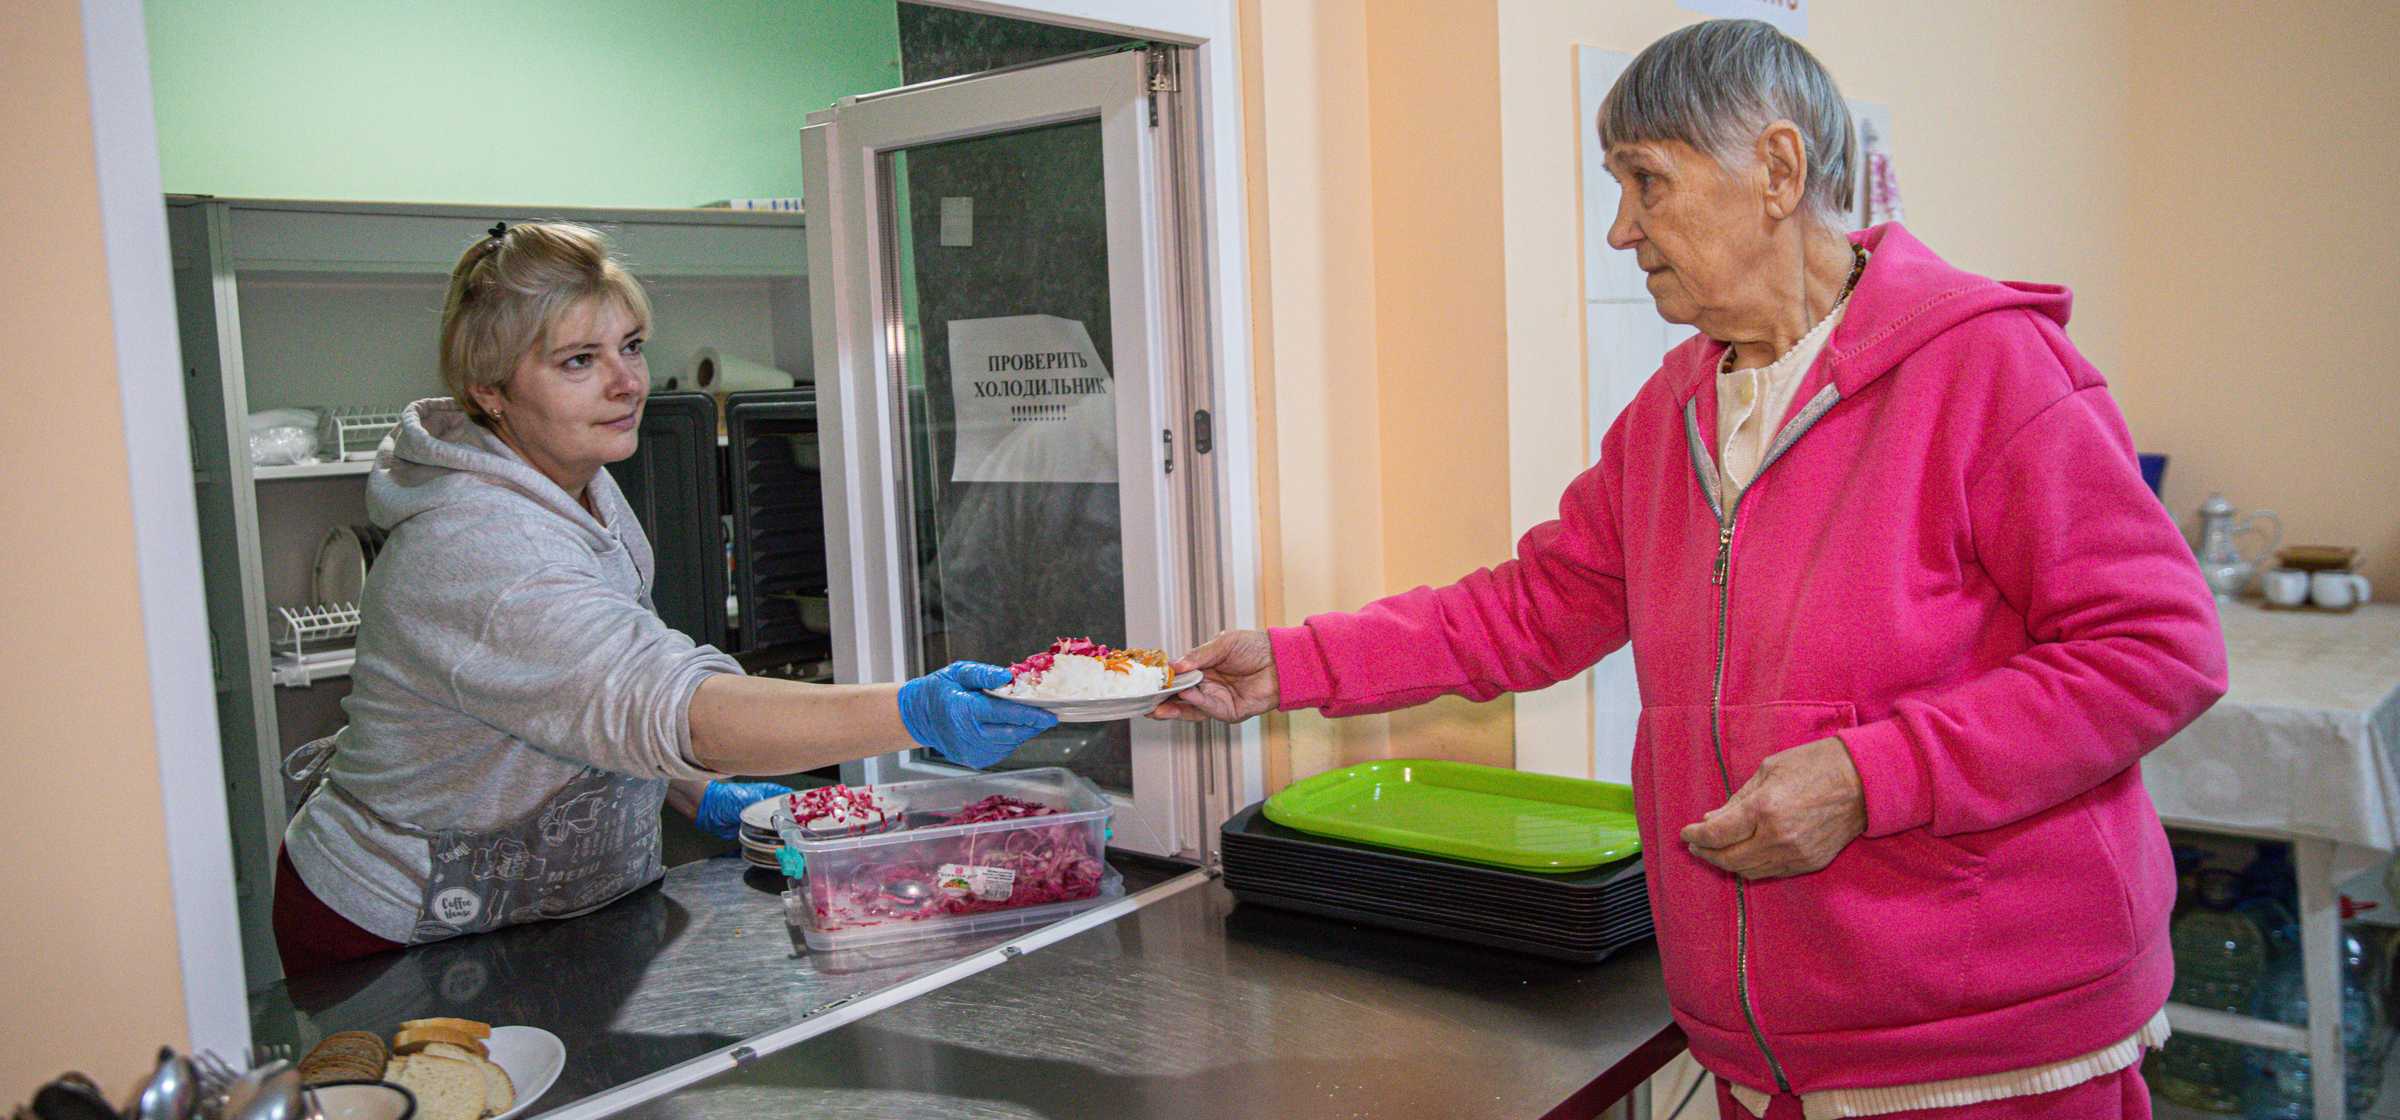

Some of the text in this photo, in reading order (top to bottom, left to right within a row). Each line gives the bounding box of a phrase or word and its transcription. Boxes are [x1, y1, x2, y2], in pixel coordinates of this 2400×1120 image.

[988, 352, 1088, 371] ПРОВЕРИТЬ
[974, 377, 1107, 398] ХОЛОДИЛЬНИК
[441, 896, 473, 911] Coffee
